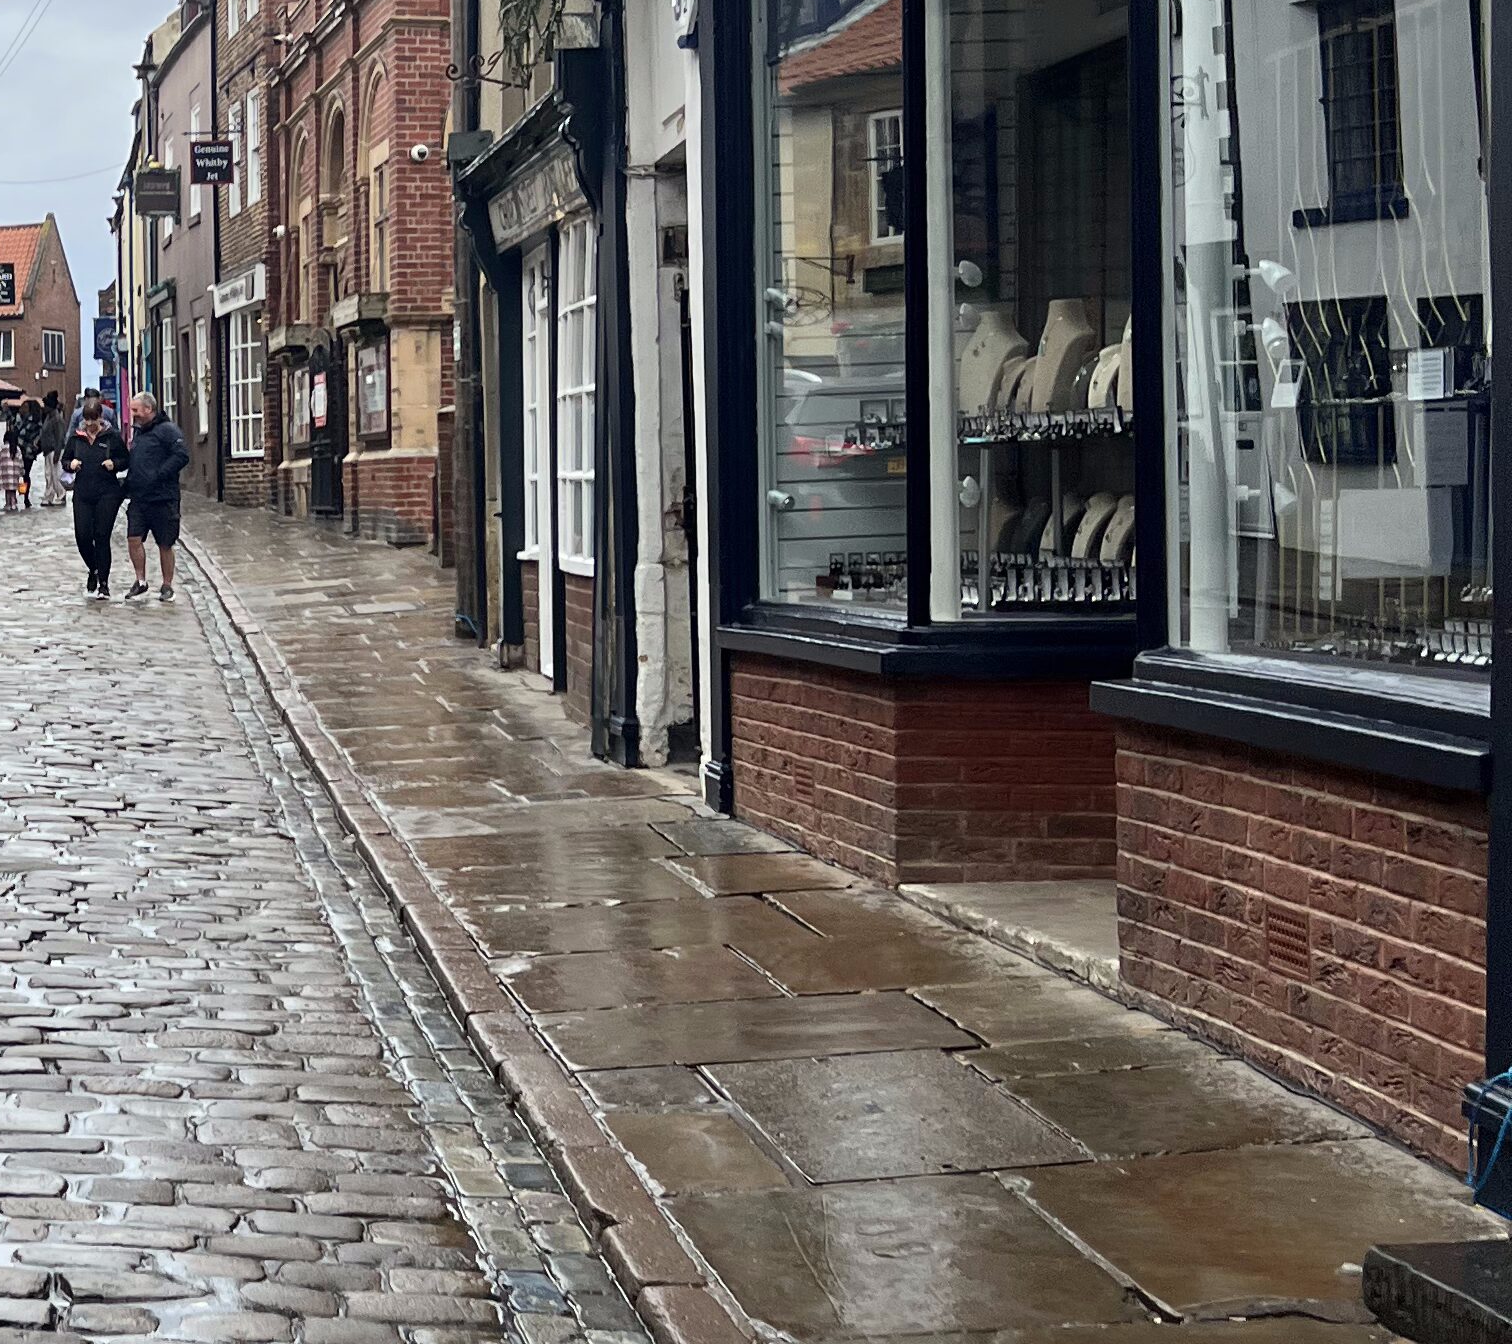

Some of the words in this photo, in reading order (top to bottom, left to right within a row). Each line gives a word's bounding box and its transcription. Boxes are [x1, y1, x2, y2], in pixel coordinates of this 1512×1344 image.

[194, 145, 229, 154] Genuine
[195, 157, 228, 168] Whitby
[207, 171, 219, 181] Jet
